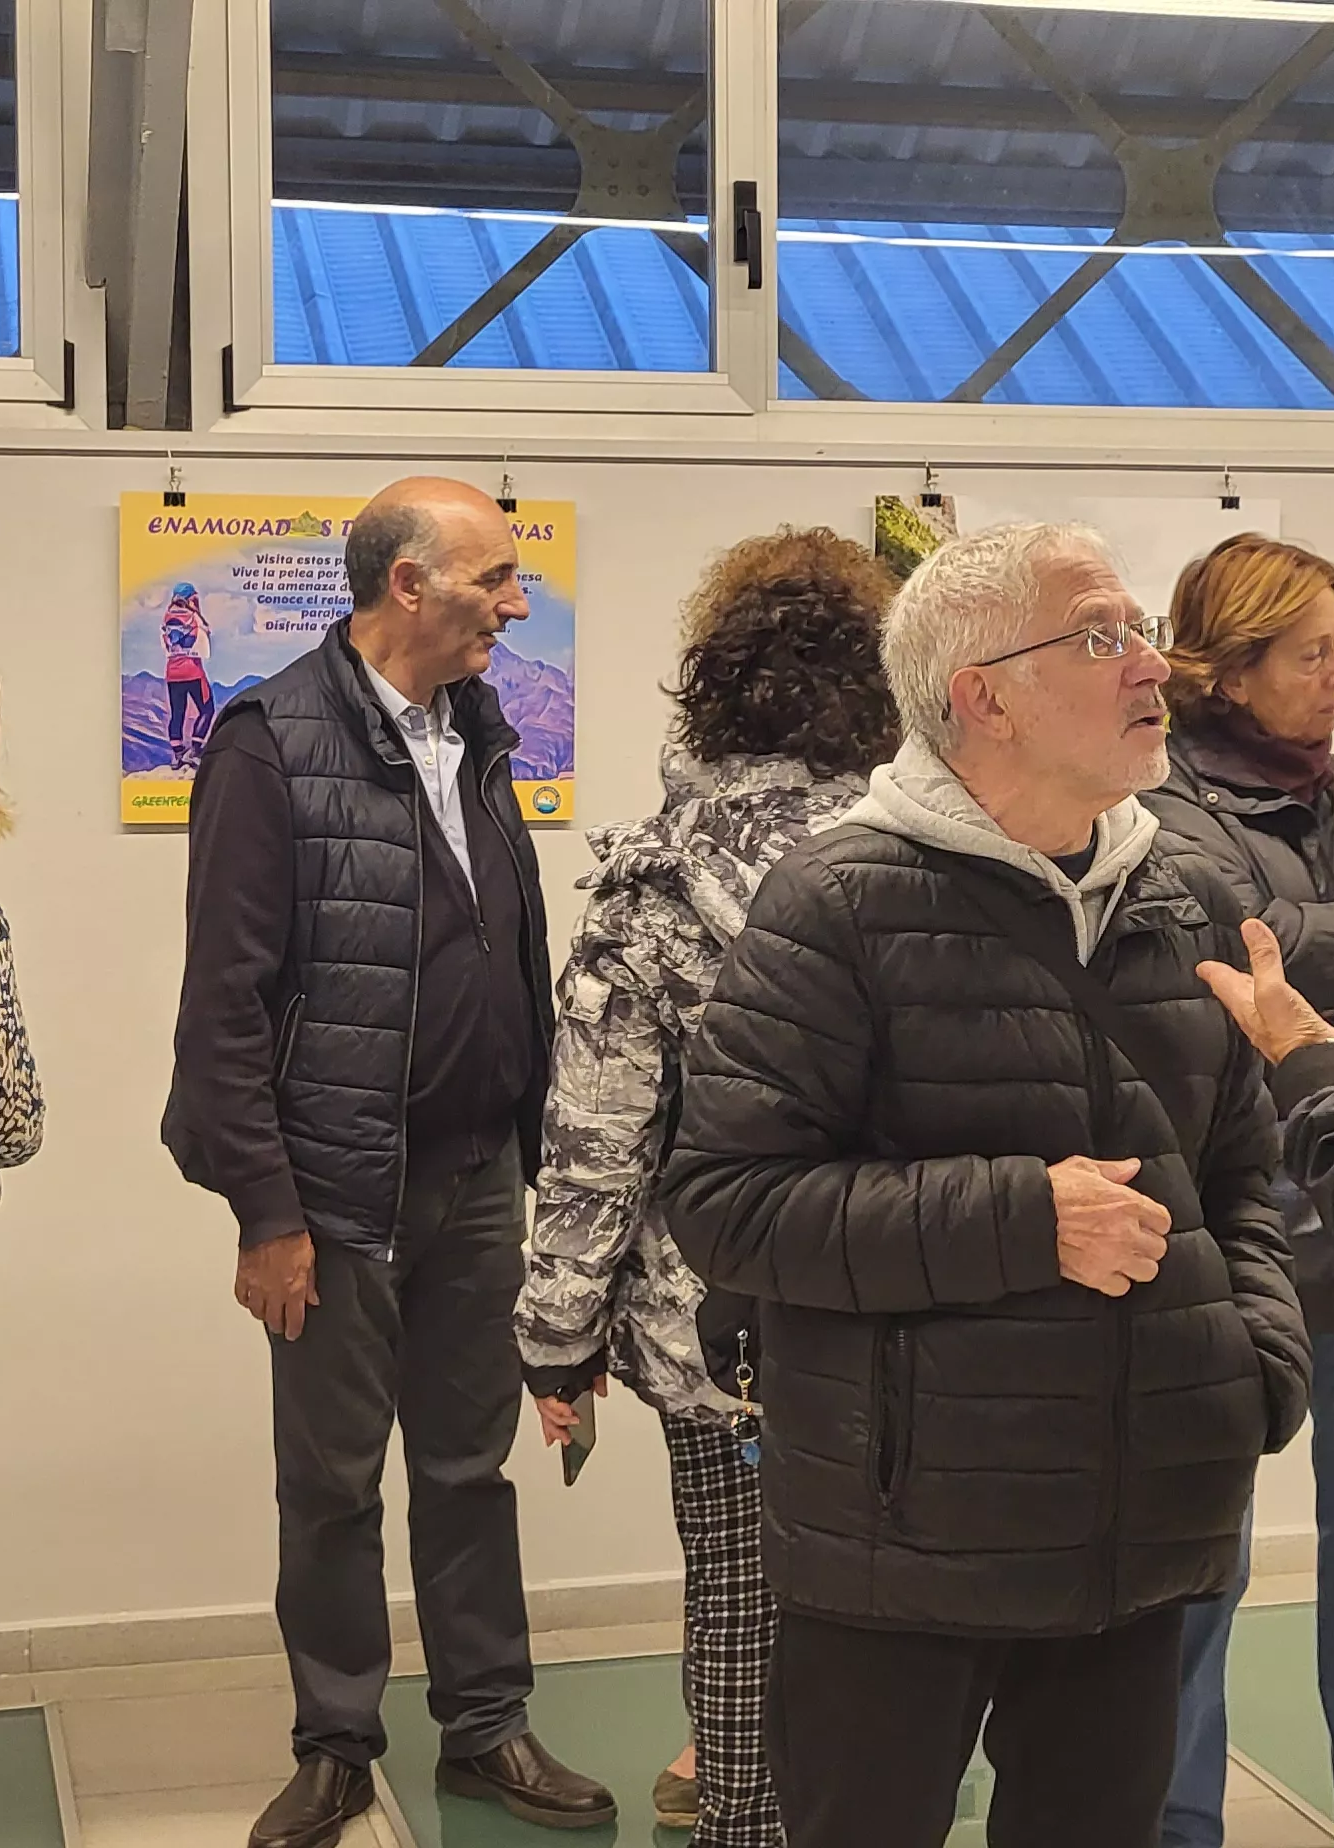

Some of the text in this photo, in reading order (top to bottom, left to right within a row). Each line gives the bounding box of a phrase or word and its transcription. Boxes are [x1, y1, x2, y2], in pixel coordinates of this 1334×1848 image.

[510, 520, 554, 541] ÑAS
[256, 553, 294, 565] Visita
[296, 556, 332, 566] estos
[232, 566, 260, 578] Vive
[263, 567, 276, 578] la
[278, 568, 314, 580] pelea
[317, 570, 340, 581] por
[242, 580, 259, 591] de
[261, 580, 274, 591] la
[277, 582, 337, 592] amenaza
[257, 594, 351, 605] Conoce el relat
[265, 620, 318, 632] Disfruta
